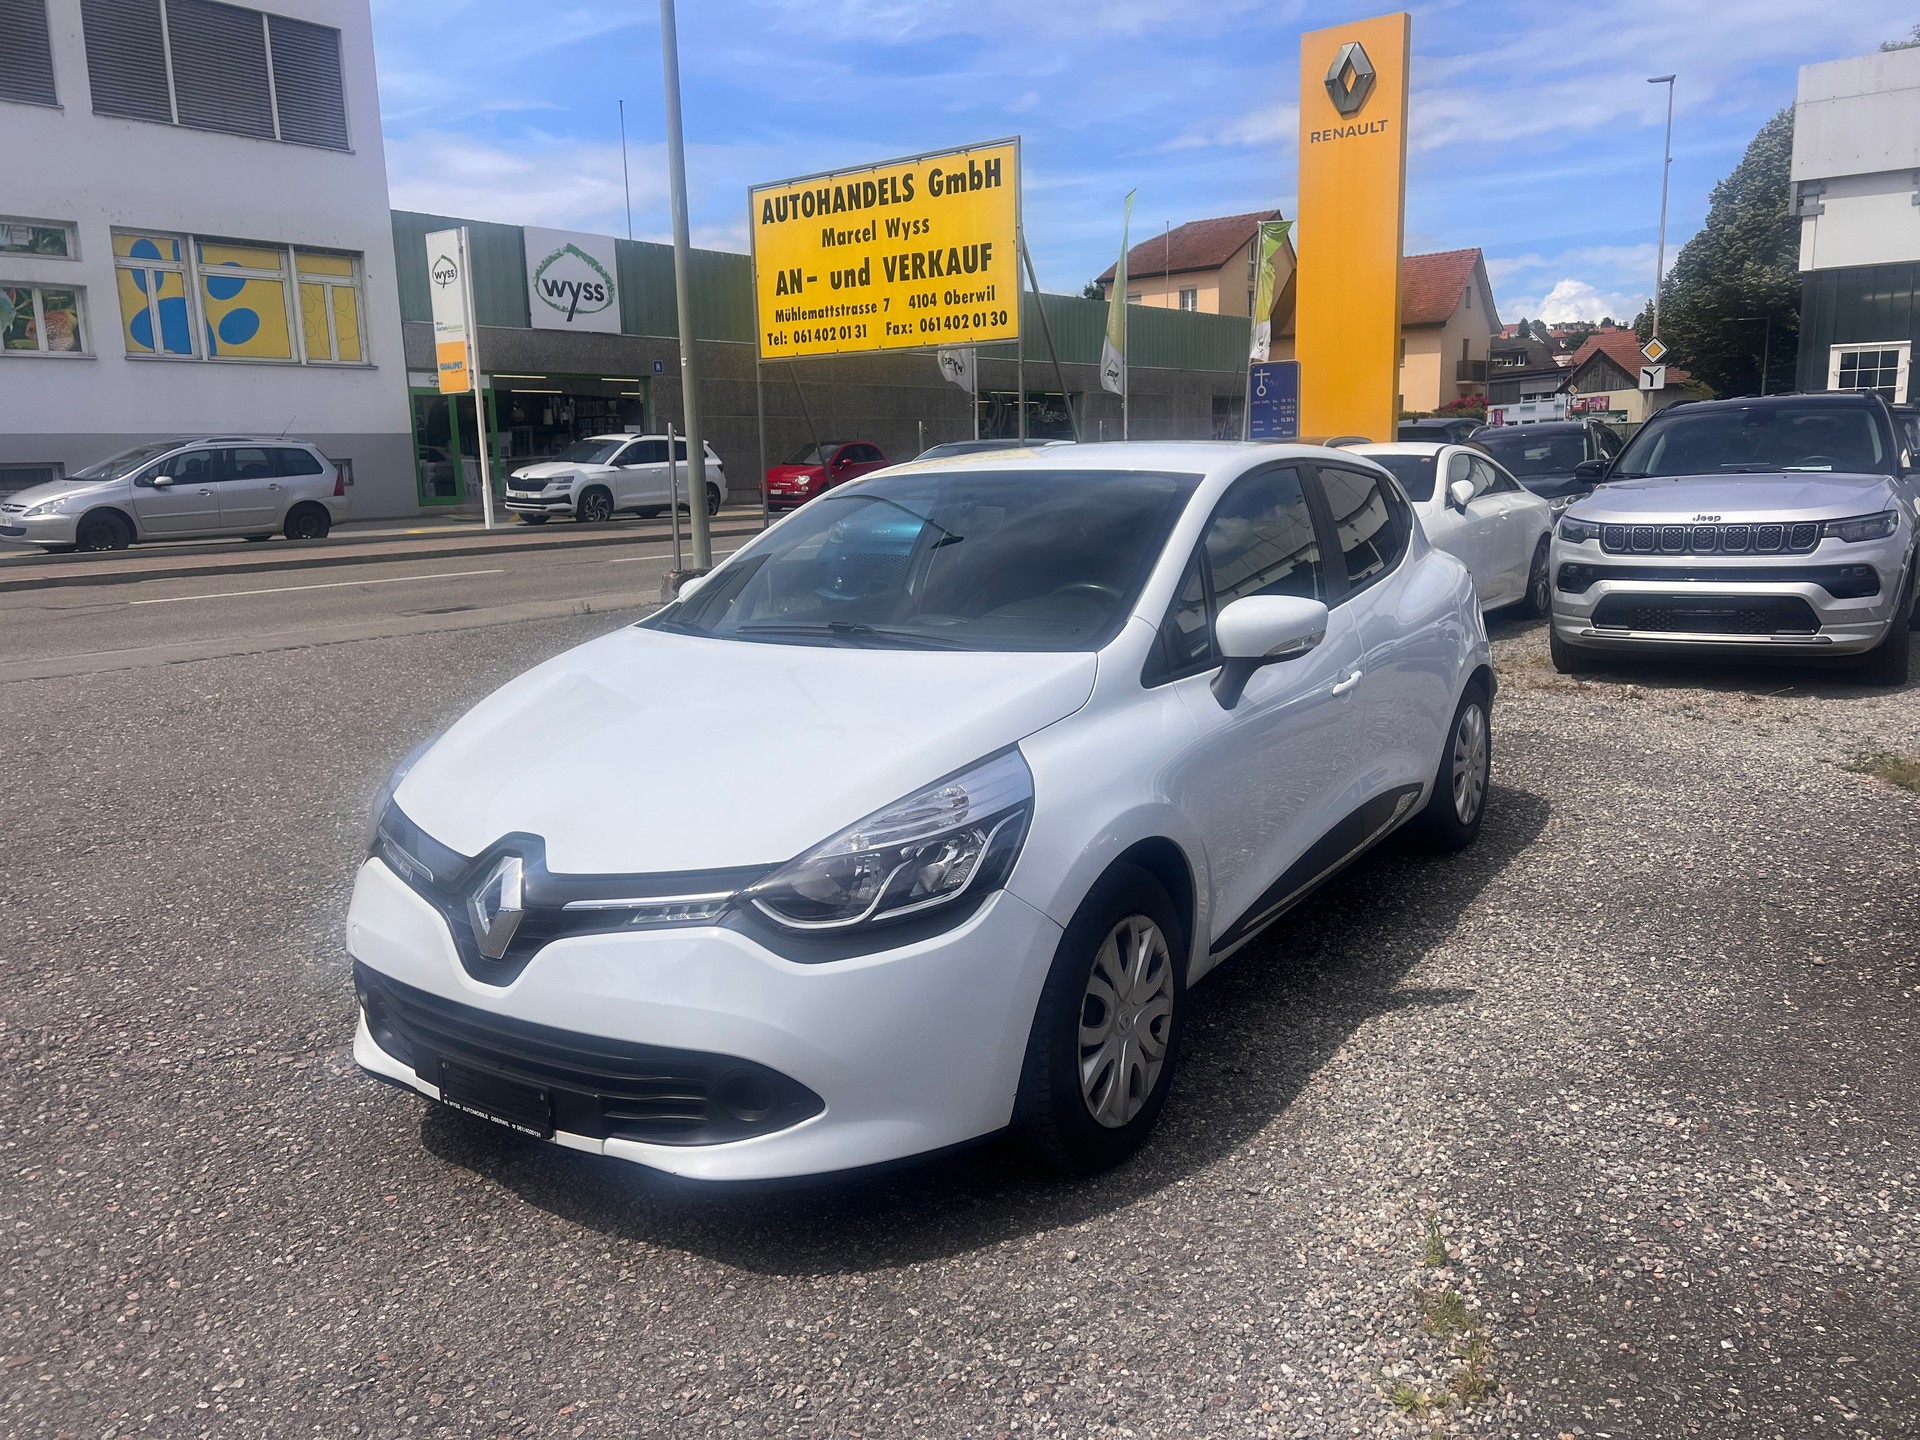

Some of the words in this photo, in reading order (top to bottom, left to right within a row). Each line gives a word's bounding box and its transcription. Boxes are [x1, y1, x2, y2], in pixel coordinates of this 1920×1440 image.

[1310, 119, 1389, 144] RENAULT
[761, 173, 915, 225] AUTOHANDELS
[928, 157, 1001, 197] GmbH
[821, 218, 877, 248] Marcel
[885, 217, 930, 241] Wyss
[433, 268, 455, 288] wyss
[775, 268, 818, 296] AN-
[829, 256, 871, 290] und
[882, 242, 993, 283] VERKAUF
[541, 278, 605, 322] wyss
[775, 302, 878, 323] Mühlemattstrasse
[883, 297, 891, 312] 7
[908, 292, 937, 309] 4104
[944, 284, 996, 306] Oberwil
[767, 330, 788, 346] Tel:
[885, 321, 913, 336] Fax:
[1692, 514, 1722, 523] Jeep
[462, 1106, 489, 1120] AUTOMOBILE
[490, 1115, 510, 1128] OBERWIL
